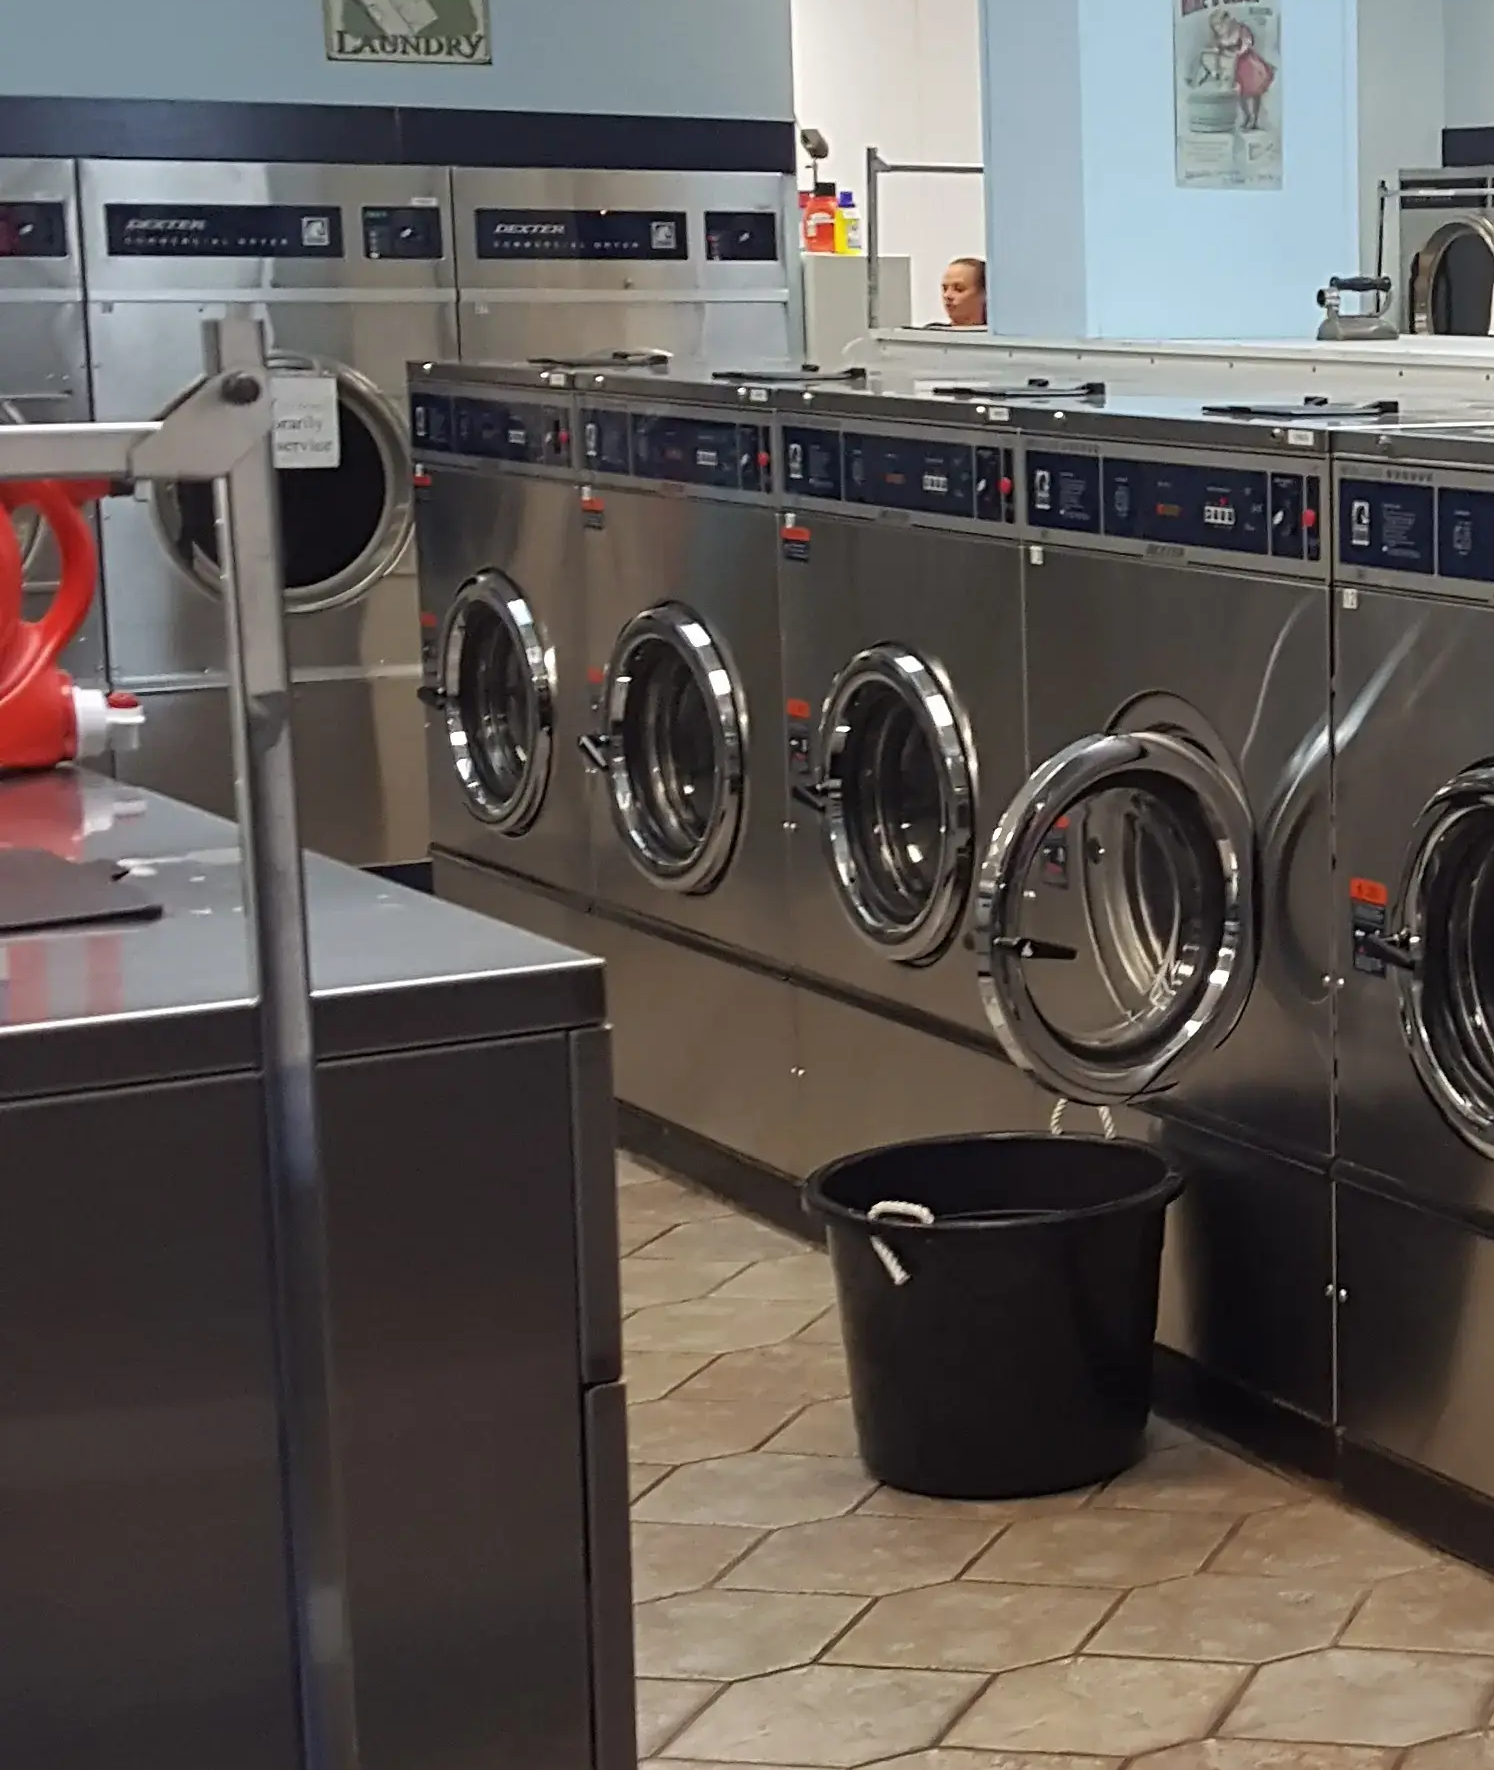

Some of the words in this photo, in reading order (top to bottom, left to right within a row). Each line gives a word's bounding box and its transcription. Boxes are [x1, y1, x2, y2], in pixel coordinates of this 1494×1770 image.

[336, 30, 484, 58] LAUNDRY
[124, 218, 207, 231] DEXTER
[493, 222, 566, 236] DEXTER
